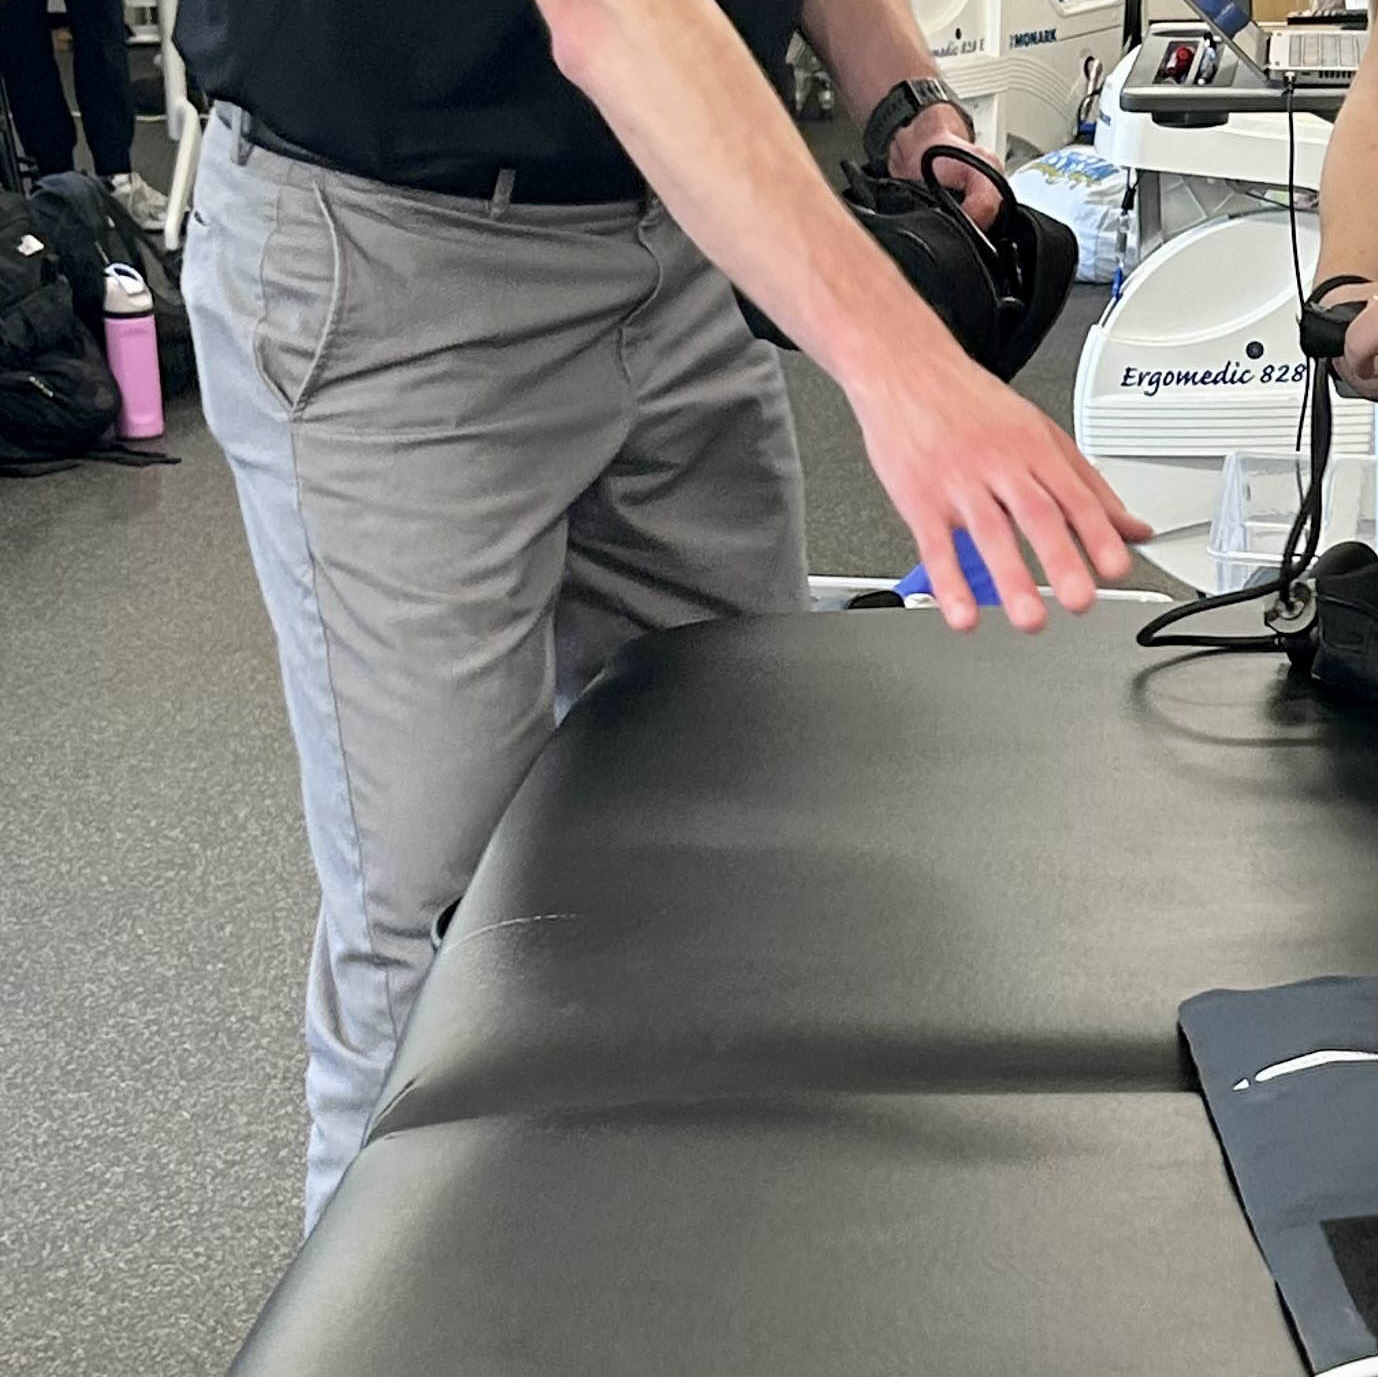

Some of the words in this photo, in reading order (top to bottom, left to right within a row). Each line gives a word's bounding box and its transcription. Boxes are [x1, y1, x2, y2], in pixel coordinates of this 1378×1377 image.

[1014, 28, 1057, 48] MONARK
[1120, 360, 1256, 397] Ergomedic
[1260, 362, 1307, 385] 828
